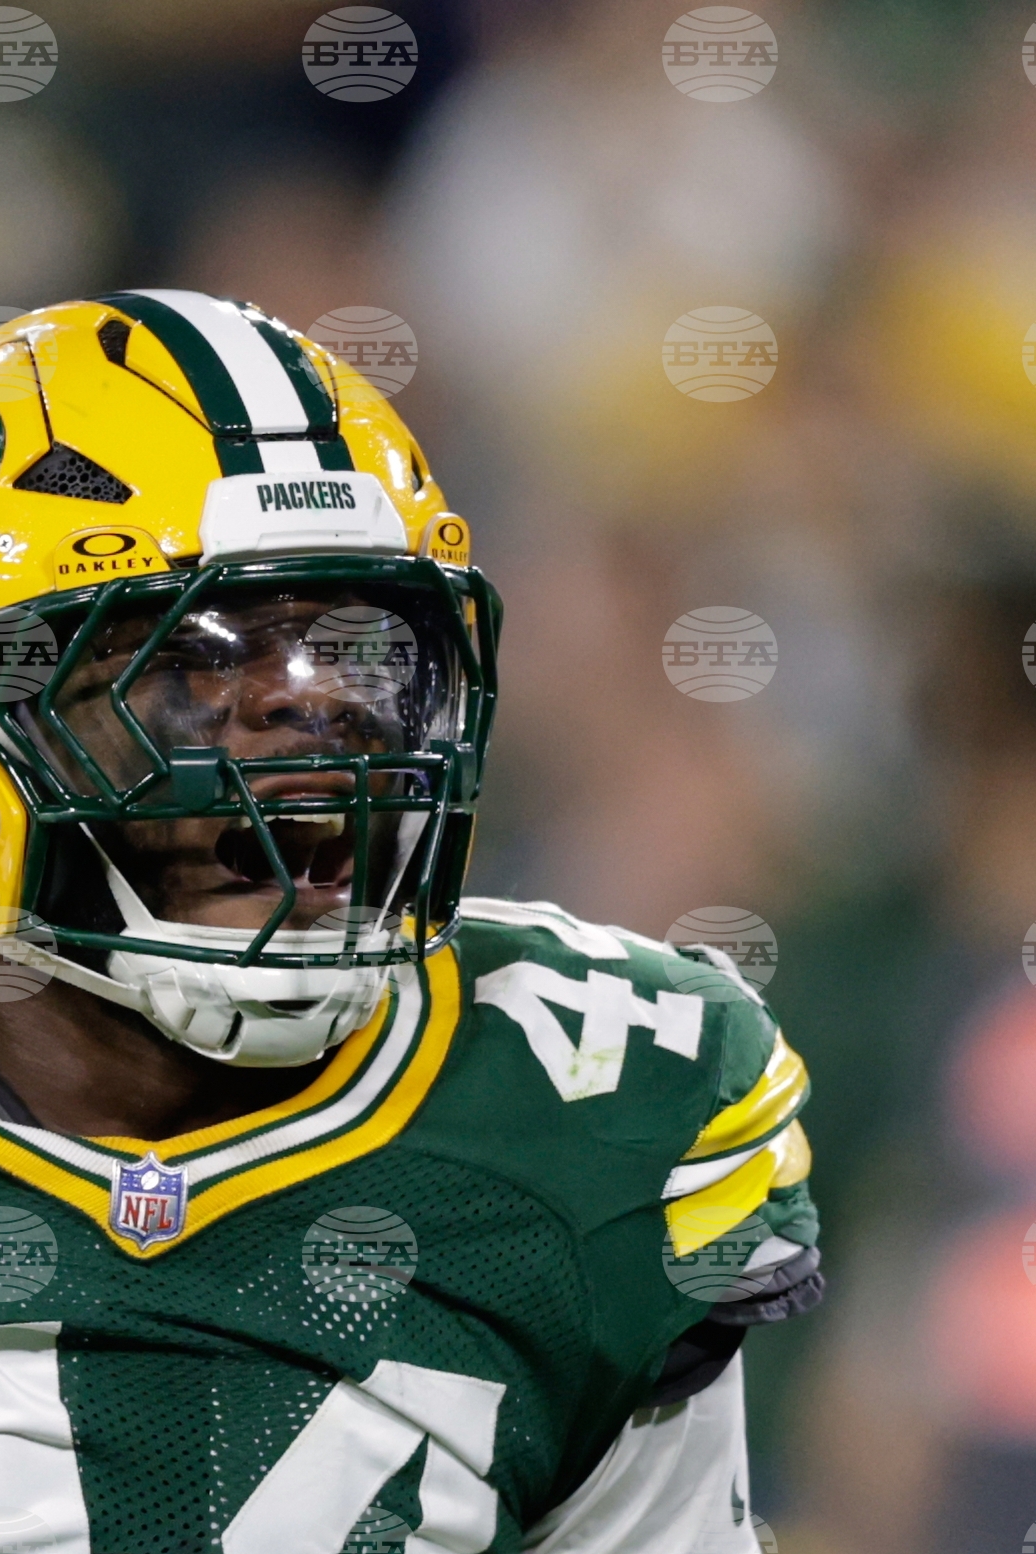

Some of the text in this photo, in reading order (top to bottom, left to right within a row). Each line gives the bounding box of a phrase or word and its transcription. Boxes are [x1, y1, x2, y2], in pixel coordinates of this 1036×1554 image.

[257, 481, 357, 512] PACKERS
[58, 557, 153, 575] OAKLEY
[122, 1195, 173, 1233] NFL
